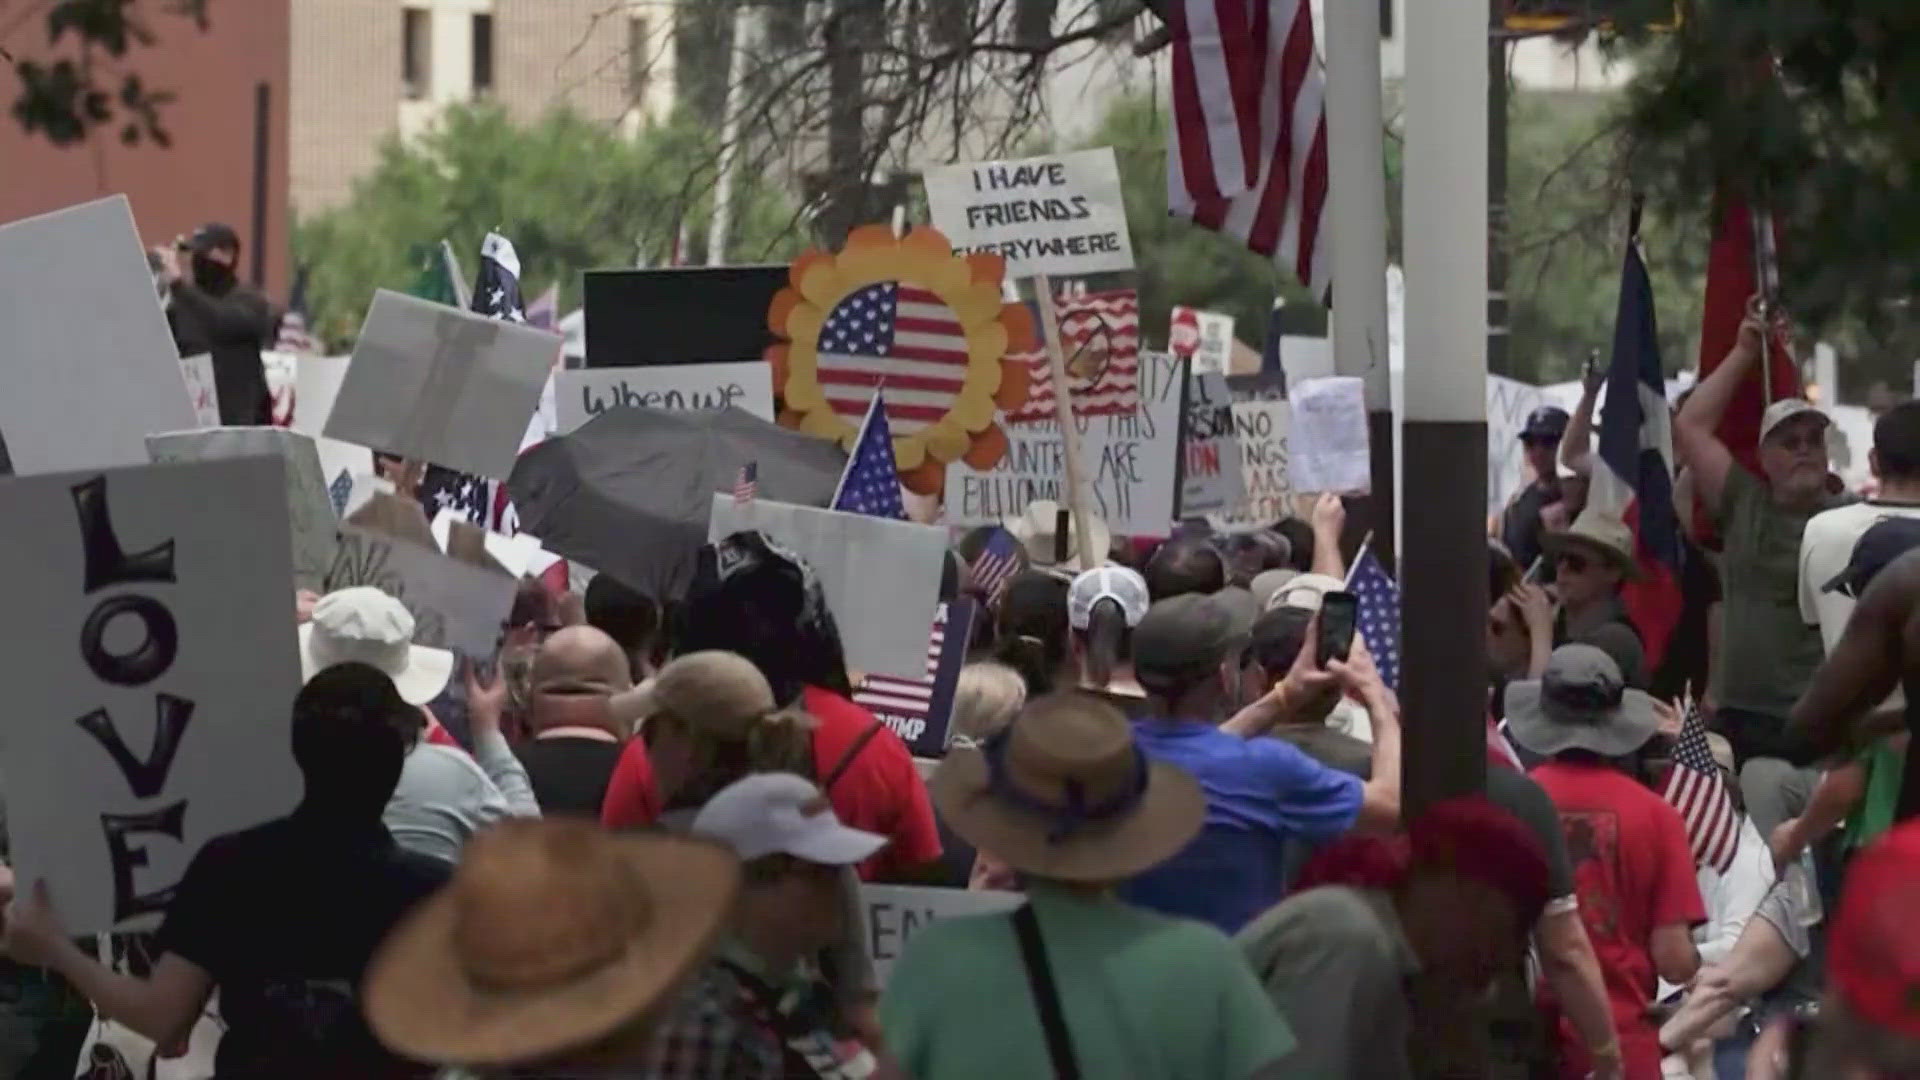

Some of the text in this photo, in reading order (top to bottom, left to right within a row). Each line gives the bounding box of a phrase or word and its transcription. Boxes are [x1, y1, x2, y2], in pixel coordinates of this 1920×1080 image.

[973, 162, 1067, 192] I HAVE
[966, 195, 1091, 230] FRIENDS
[582, 380, 686, 416] When
[1236, 410, 1272, 440] NO
[1099, 441, 1144, 483] ARE
[71, 474, 195, 924] LOVE
